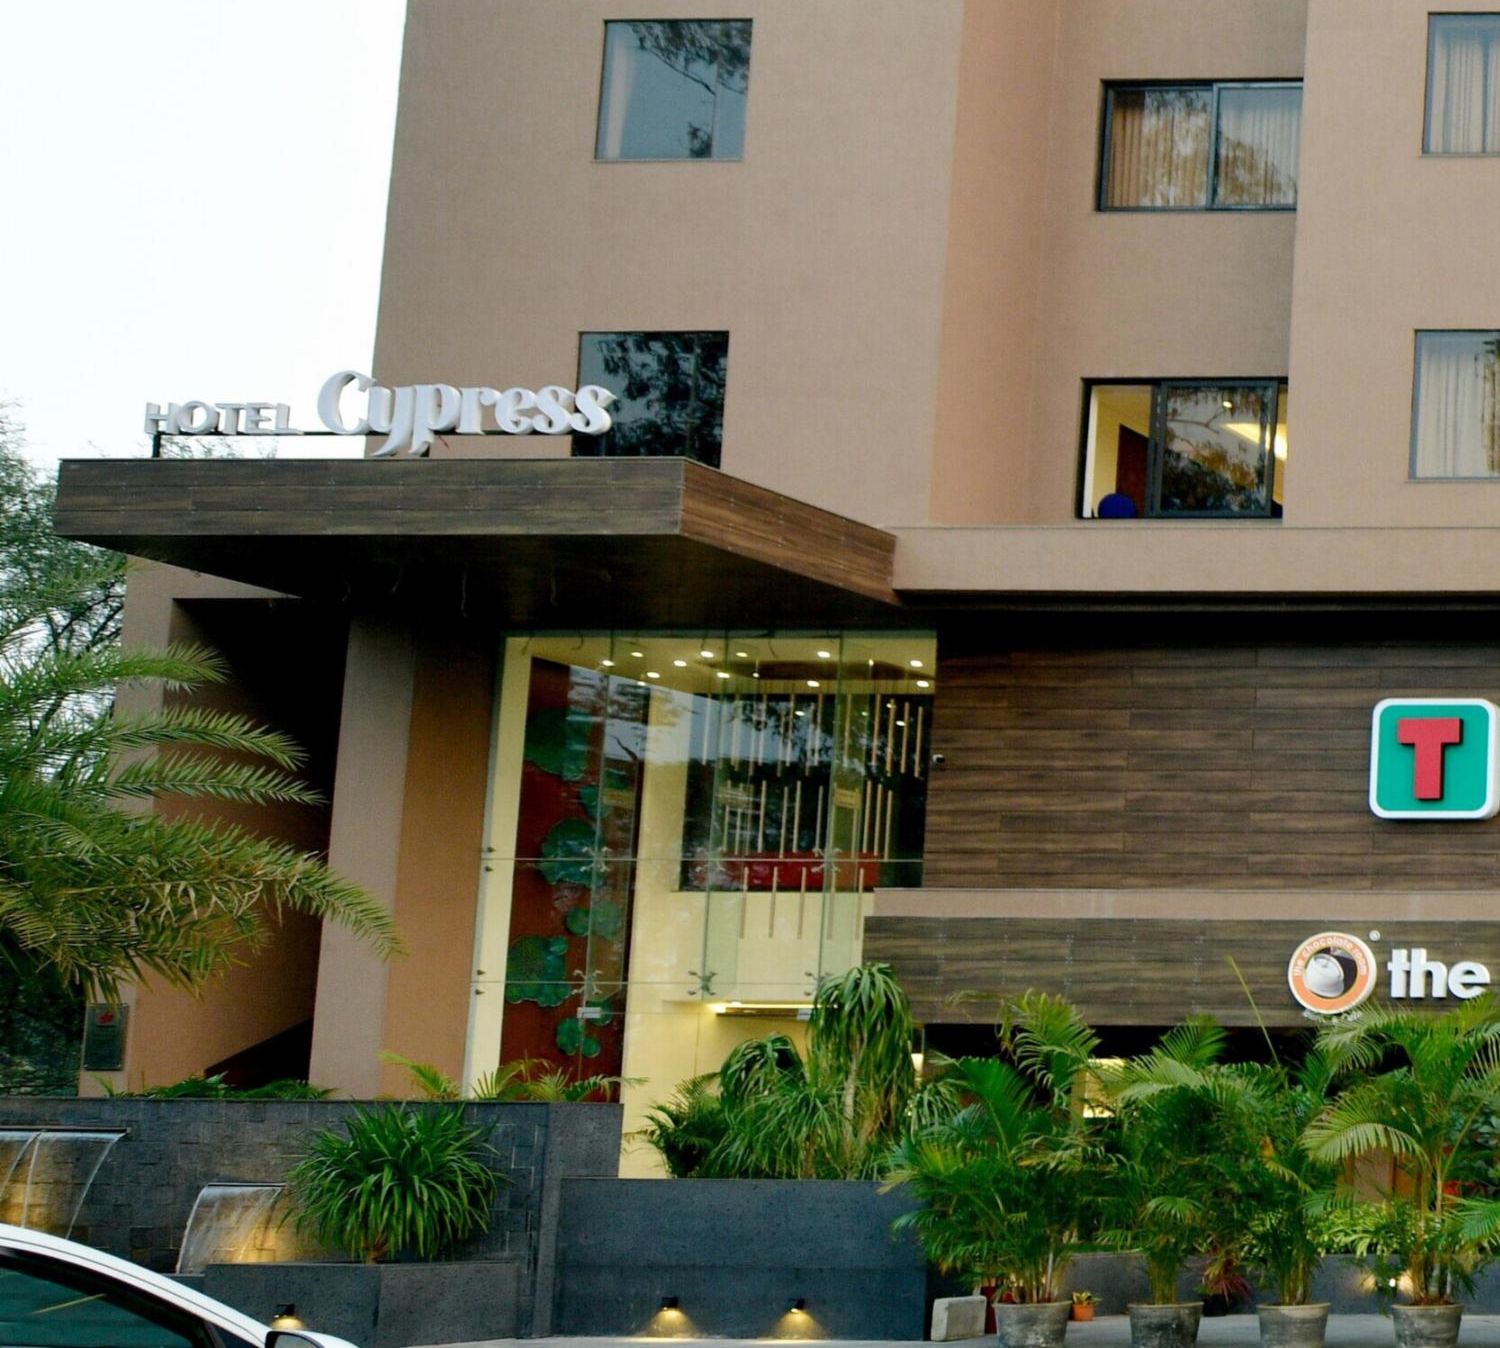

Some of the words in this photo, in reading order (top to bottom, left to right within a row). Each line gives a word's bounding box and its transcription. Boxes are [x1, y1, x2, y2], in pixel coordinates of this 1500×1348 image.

[144, 401, 303, 435] HOTEL
[317, 370, 618, 457] Cypress
[1387, 948, 1491, 1000] the
